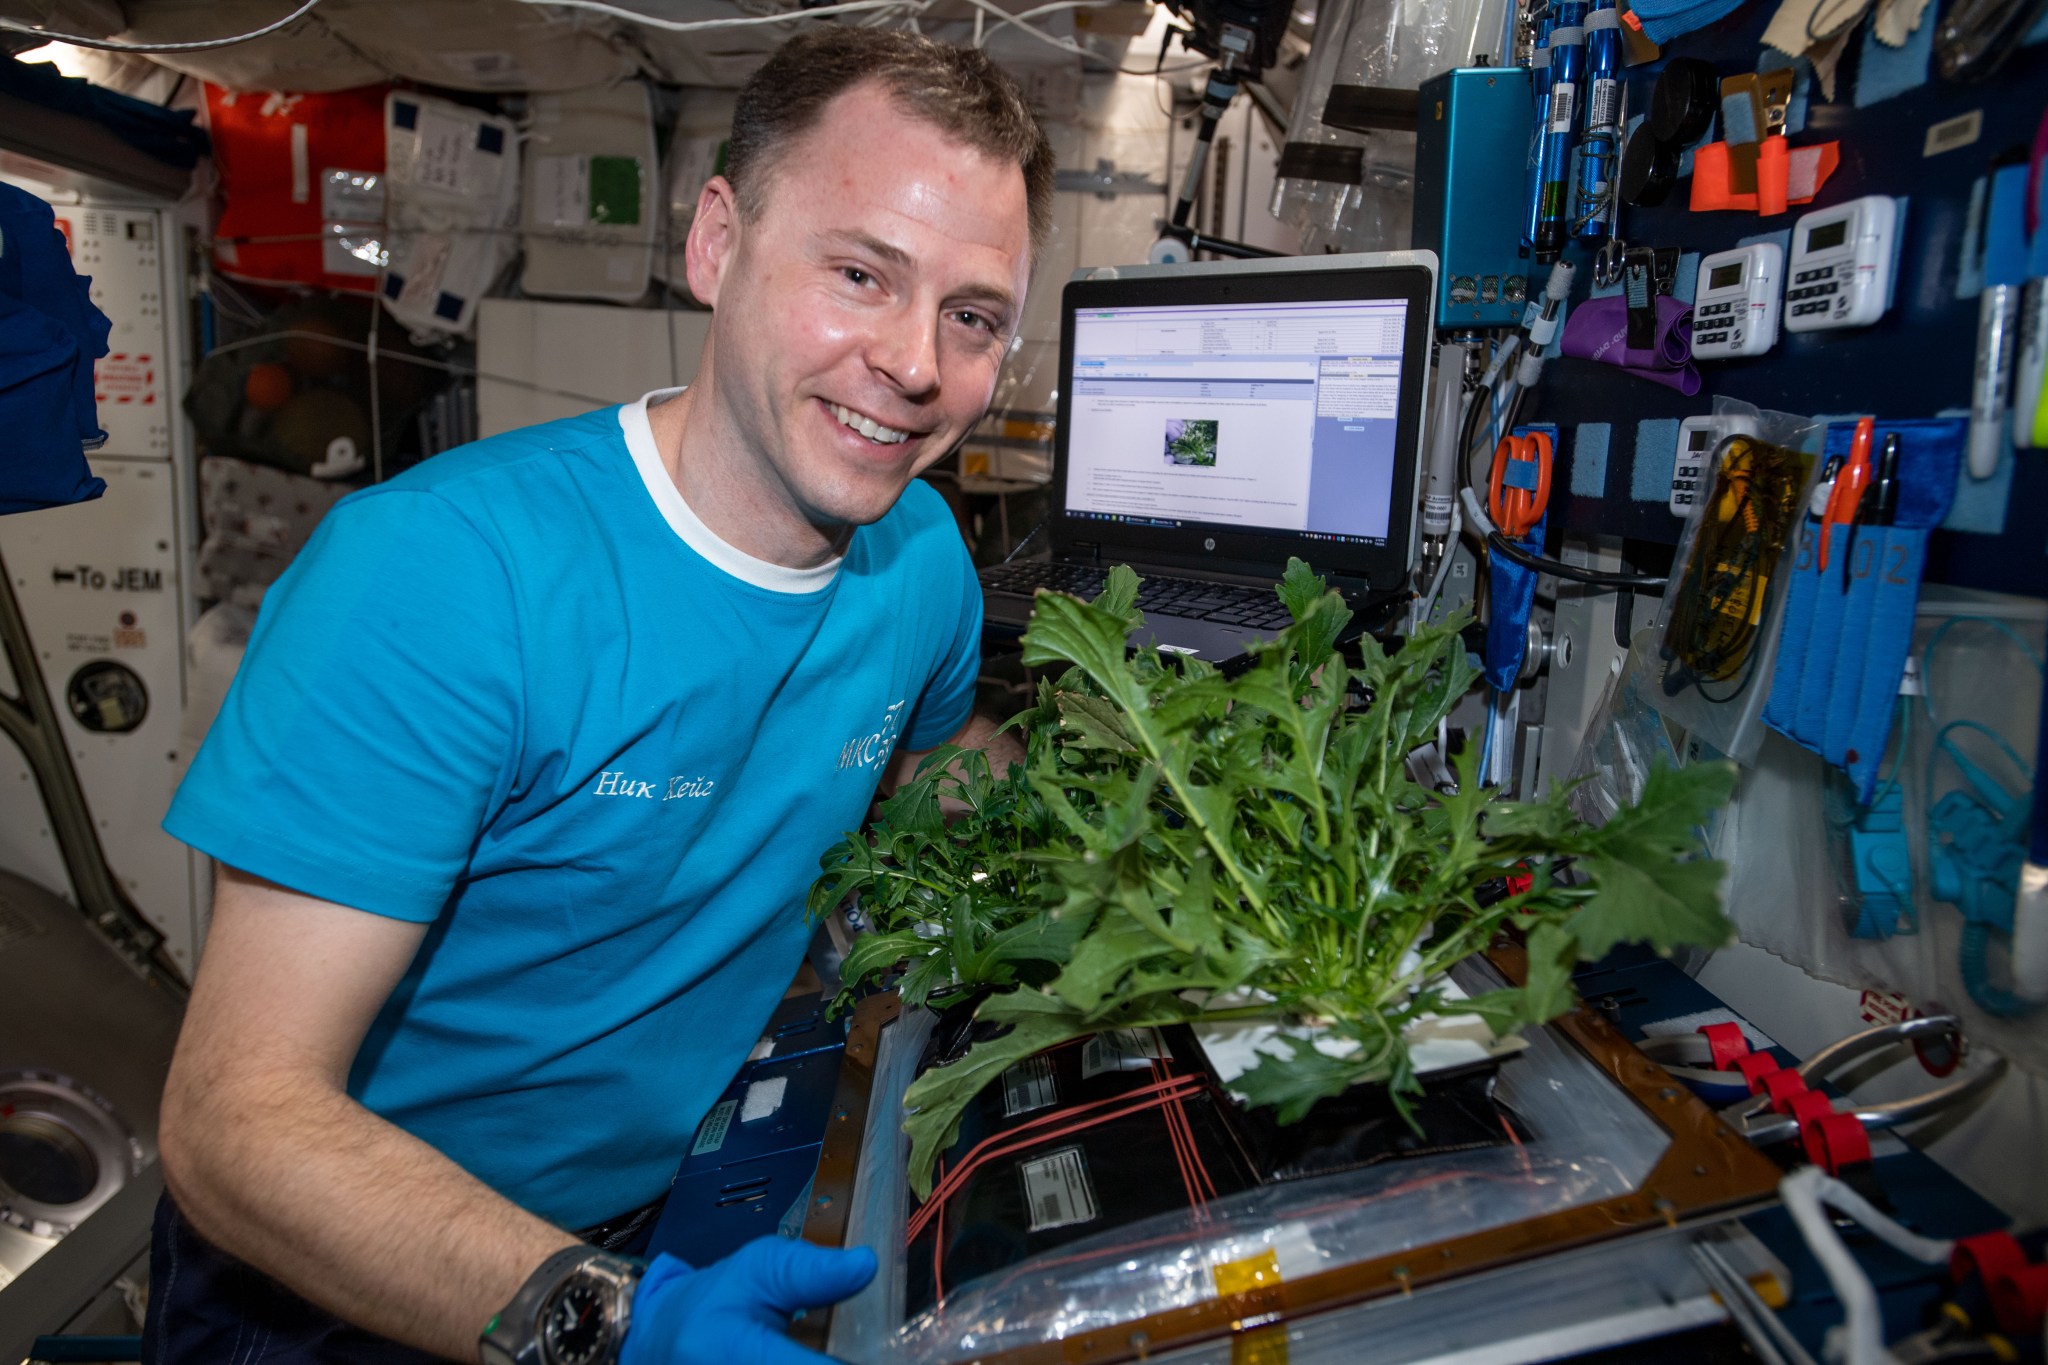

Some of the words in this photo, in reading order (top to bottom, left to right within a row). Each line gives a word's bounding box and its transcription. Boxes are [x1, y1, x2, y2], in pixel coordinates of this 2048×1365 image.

[76, 565, 106, 591] To
[111, 566, 162, 593] JEM
[593, 772, 656, 798] Ник
[662, 776, 714, 801] Хейг
